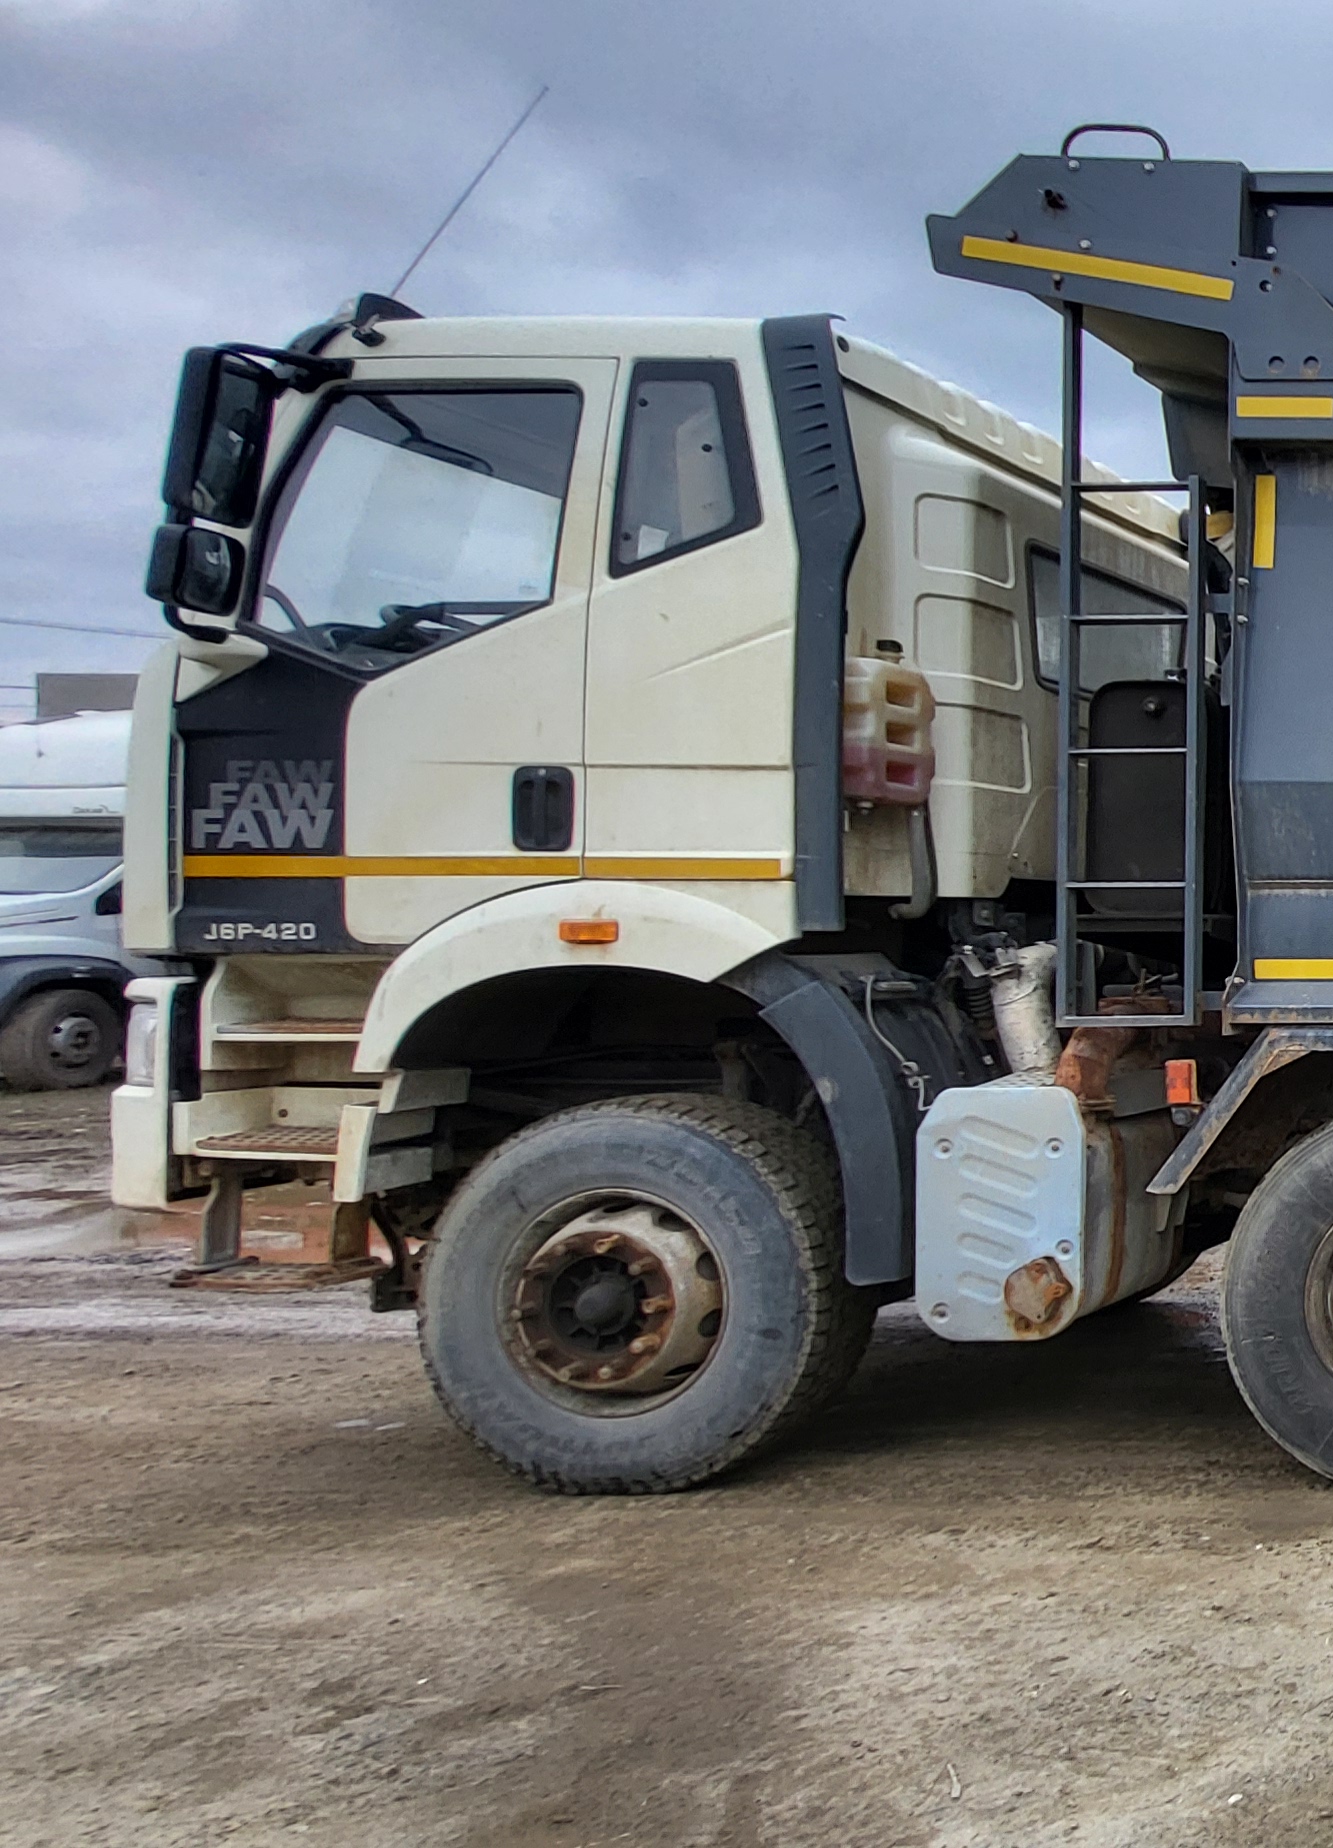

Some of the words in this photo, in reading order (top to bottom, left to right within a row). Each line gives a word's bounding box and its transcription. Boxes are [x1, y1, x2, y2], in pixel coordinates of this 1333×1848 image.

[226, 759, 334, 785] FAW
[209, 782, 335, 813] FAW
[191, 809, 335, 849] FAW
[203, 922, 317, 940] J6P-420
